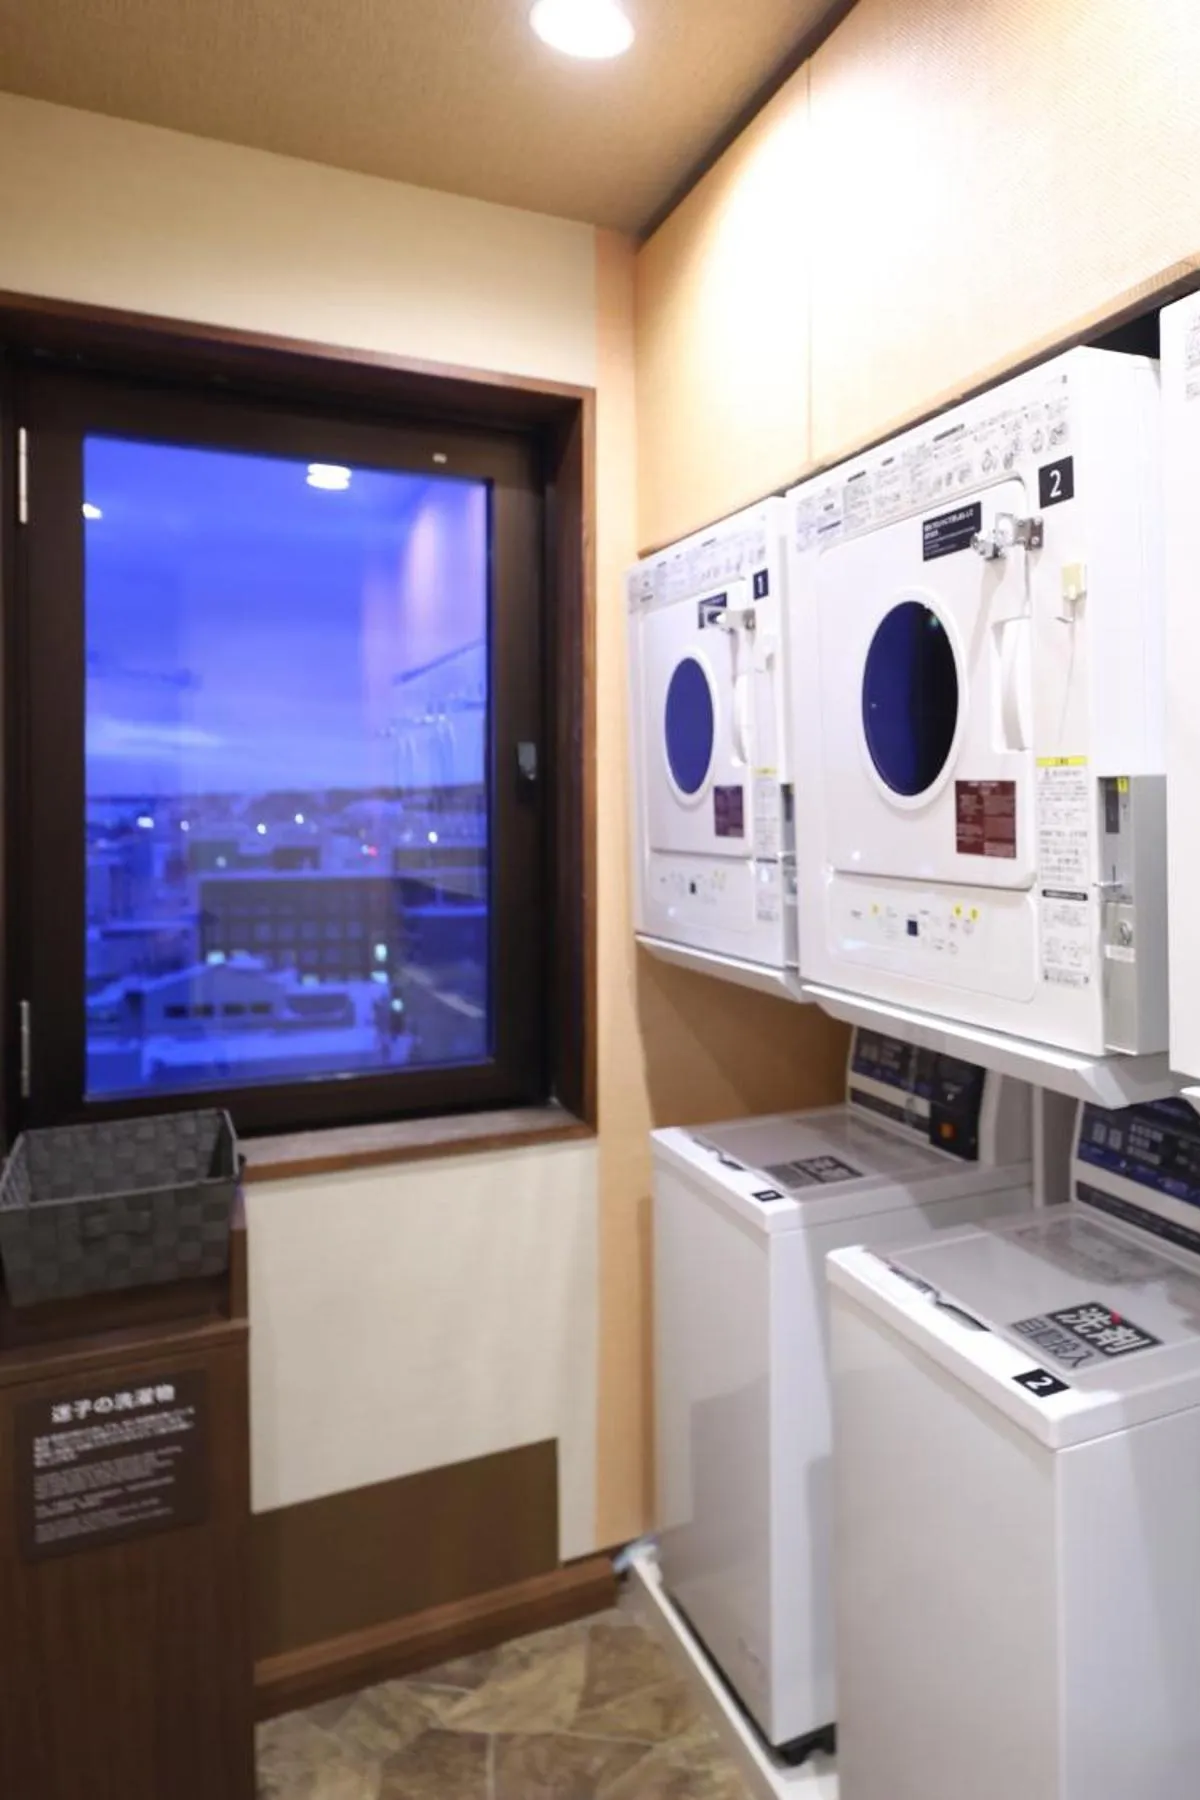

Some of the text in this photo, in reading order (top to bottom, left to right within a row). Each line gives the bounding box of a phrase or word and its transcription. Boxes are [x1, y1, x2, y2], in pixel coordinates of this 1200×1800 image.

[1050, 469, 1062, 497] 2
[1056, 1307, 1152, 1353] 洗剤
[1025, 1376, 1053, 1389] 2
